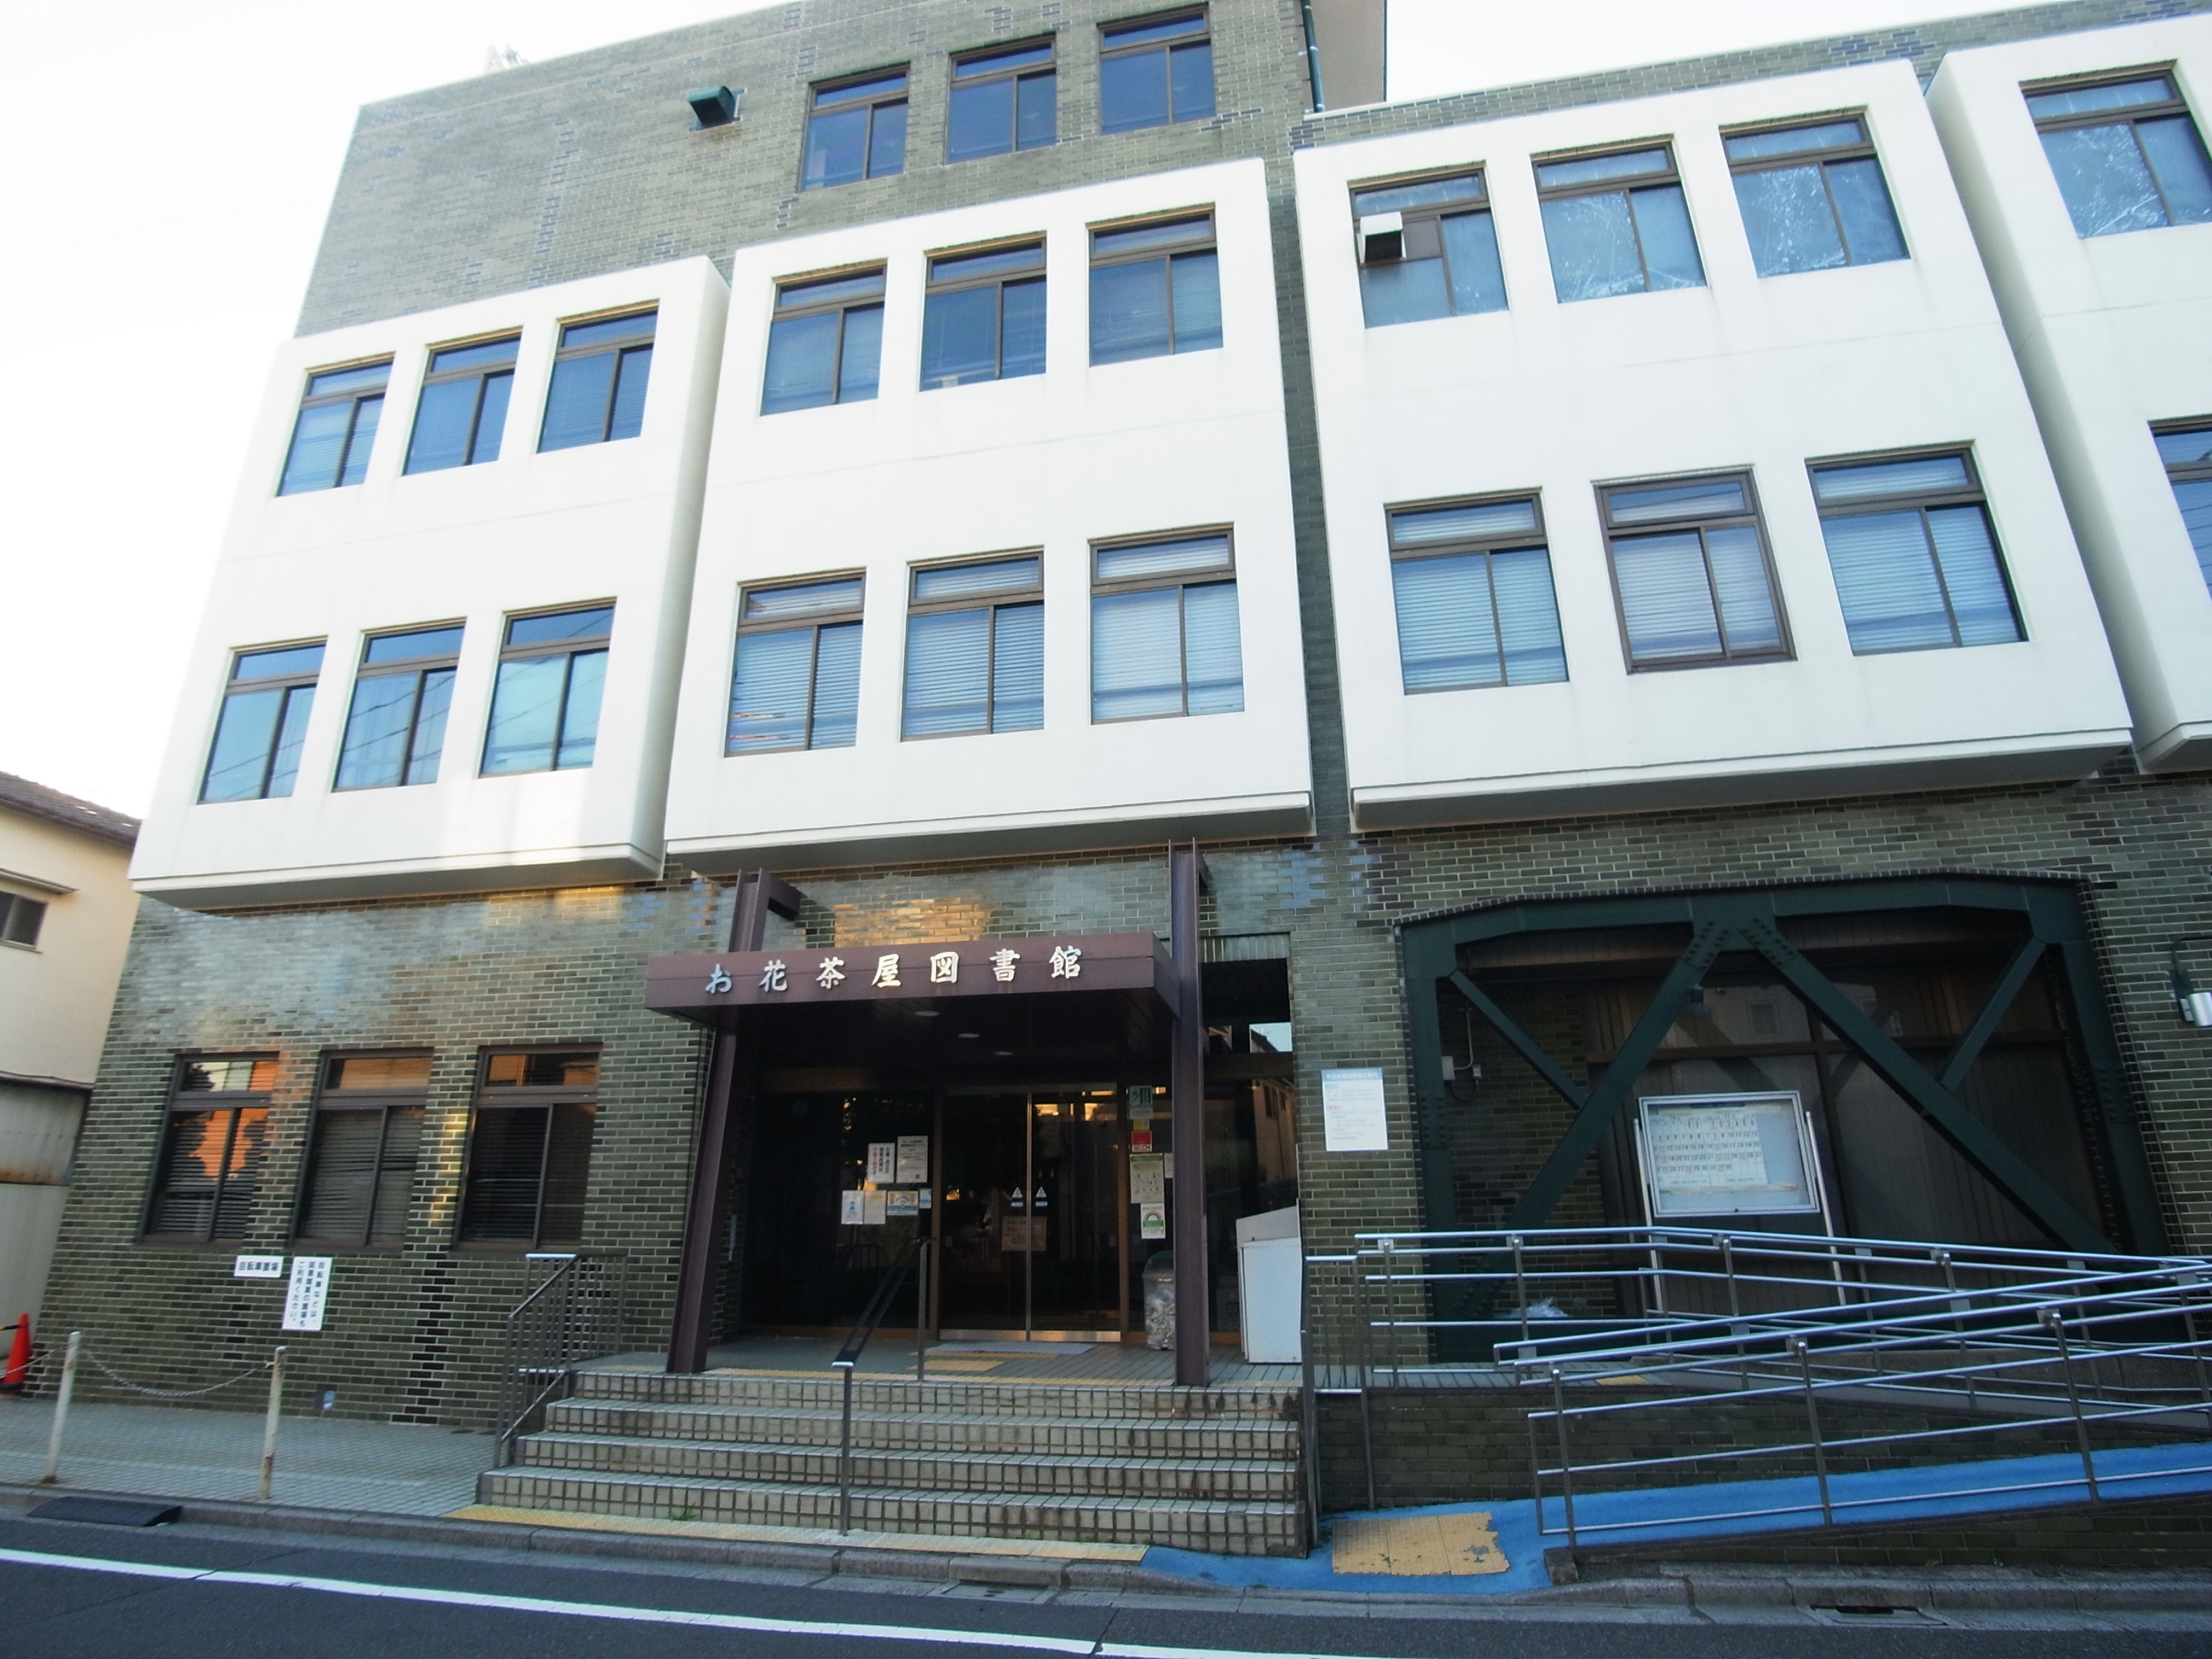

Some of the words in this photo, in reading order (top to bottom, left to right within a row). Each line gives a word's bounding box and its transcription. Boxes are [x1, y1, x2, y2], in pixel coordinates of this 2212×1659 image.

[704, 945, 1082, 995] お花茶屋図書館
[239, 1261, 279, 1271] 自転車置場
